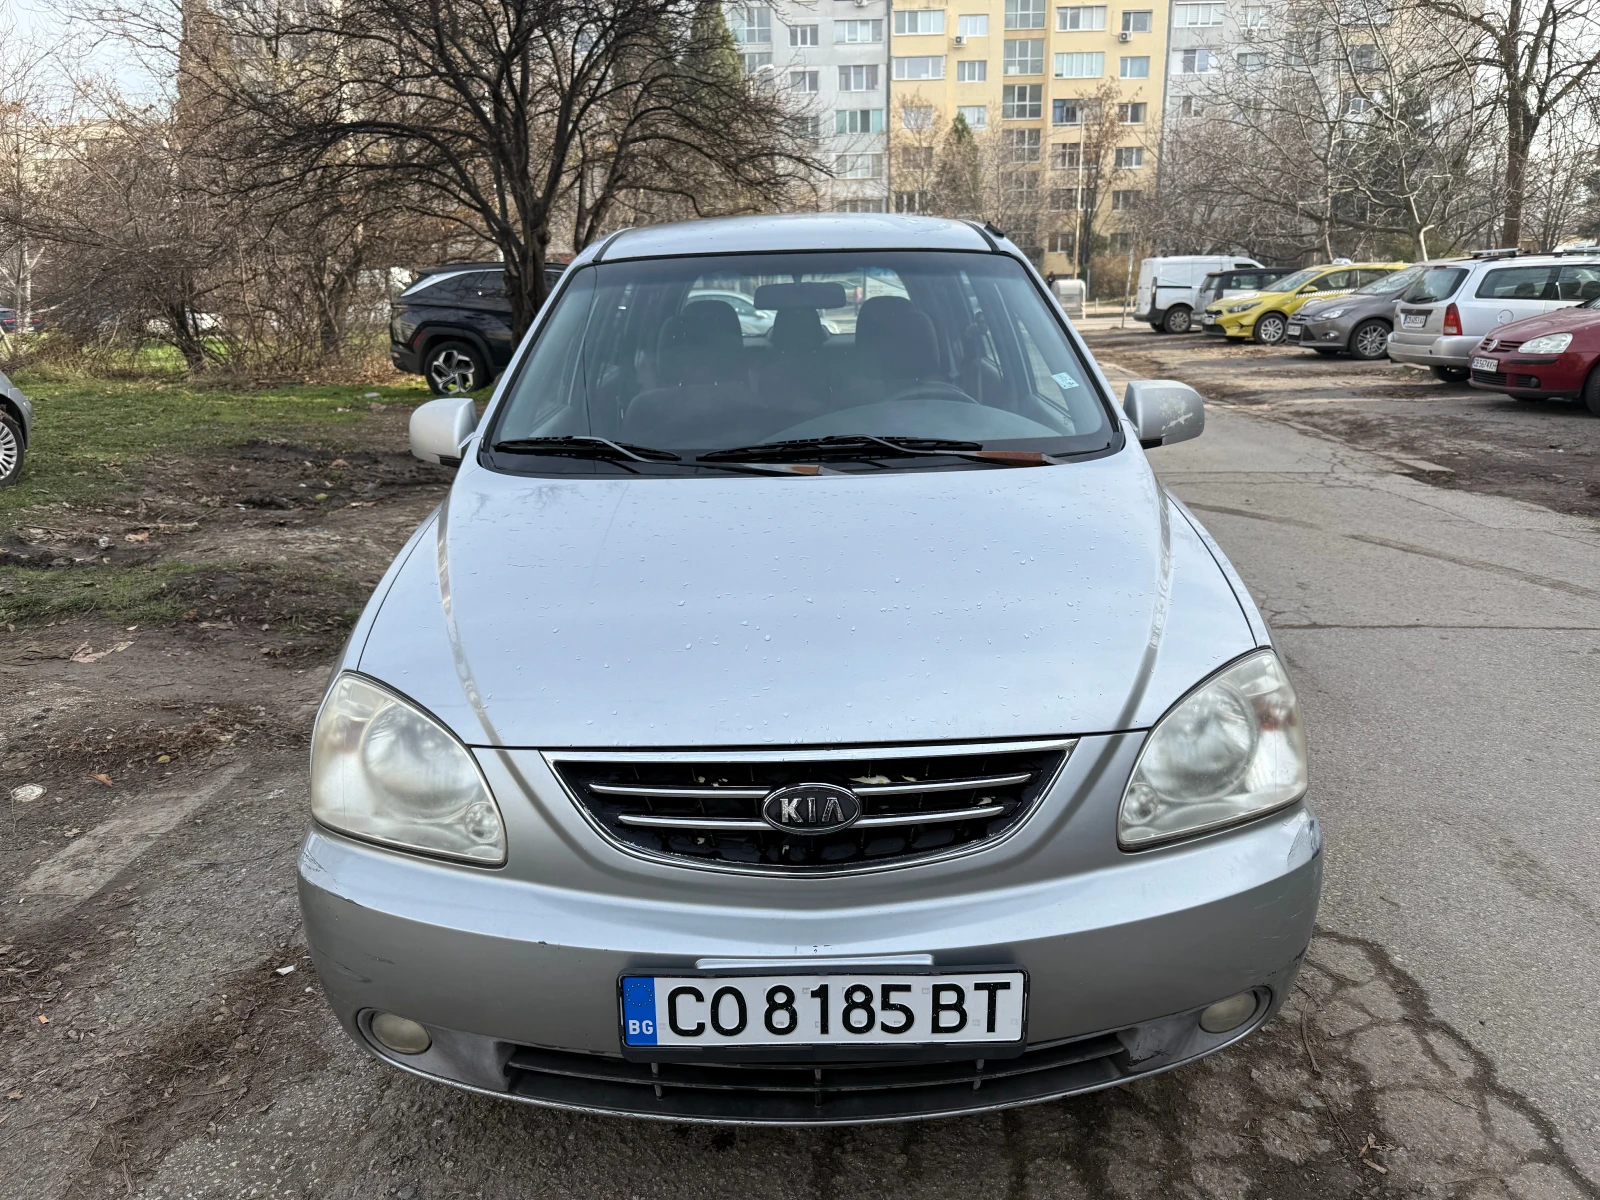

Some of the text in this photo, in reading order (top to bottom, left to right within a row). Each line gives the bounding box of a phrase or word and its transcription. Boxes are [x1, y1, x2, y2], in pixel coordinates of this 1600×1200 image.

[780, 797, 846, 822] KIA
[764, 983, 915, 1036] 8185
[931, 981, 1011, 1034] BT
[628, 1019, 654, 1035] BG
